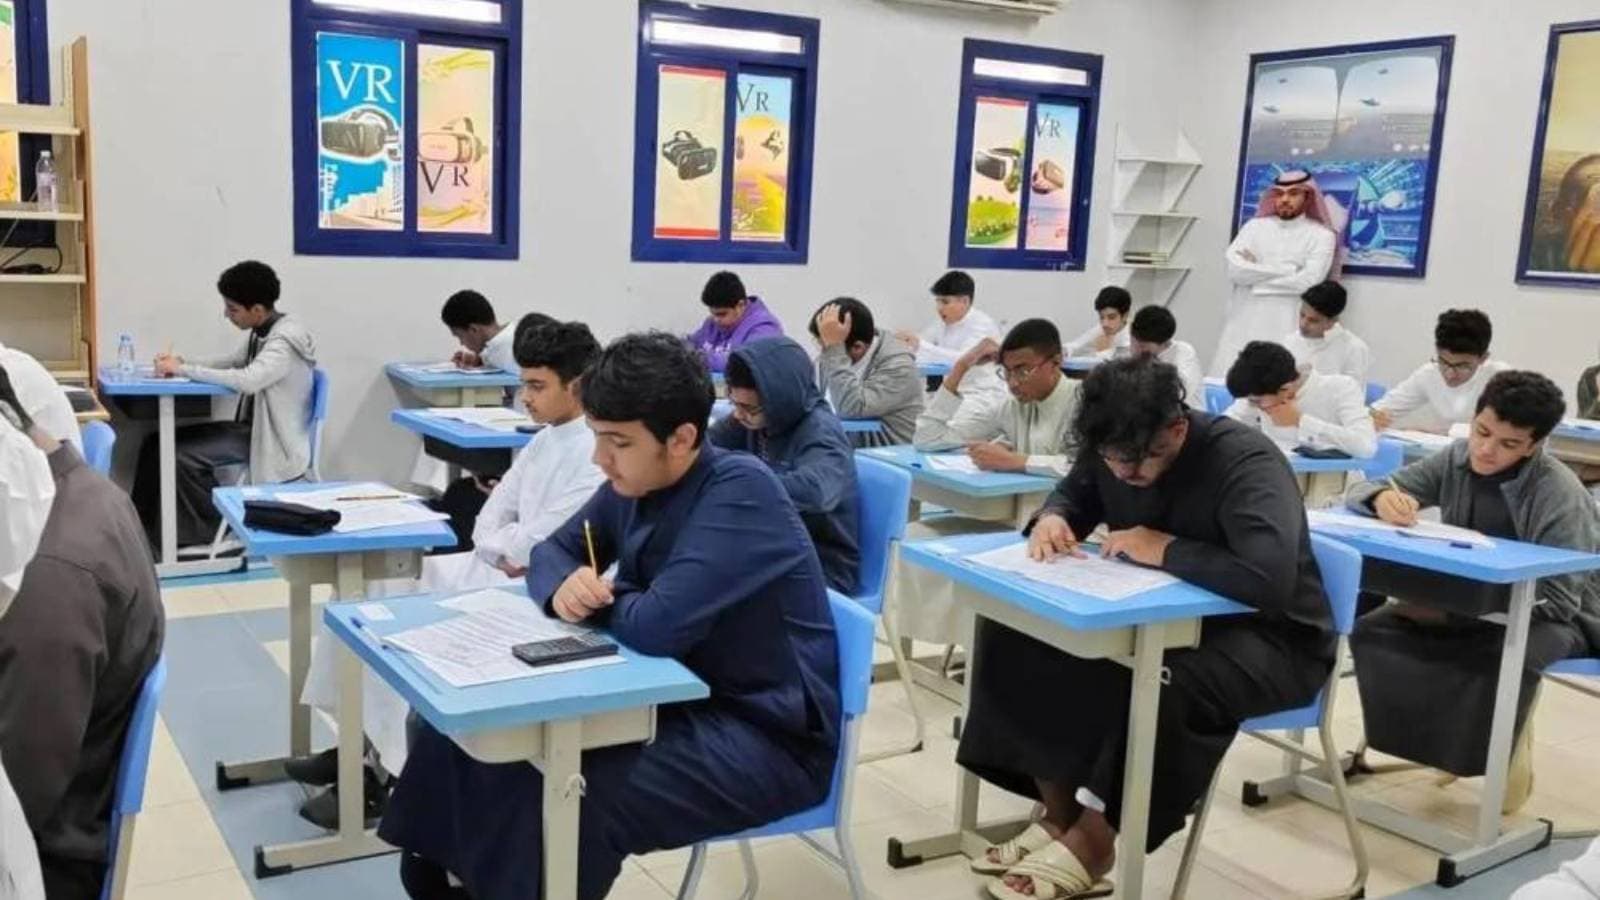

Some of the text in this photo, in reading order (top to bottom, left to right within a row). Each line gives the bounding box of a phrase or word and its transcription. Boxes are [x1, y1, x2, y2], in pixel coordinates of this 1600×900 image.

[326, 60, 397, 103] VR
[736, 83, 769, 112] VR
[1035, 112, 1062, 138] VR
[420, 161, 469, 194] VR
